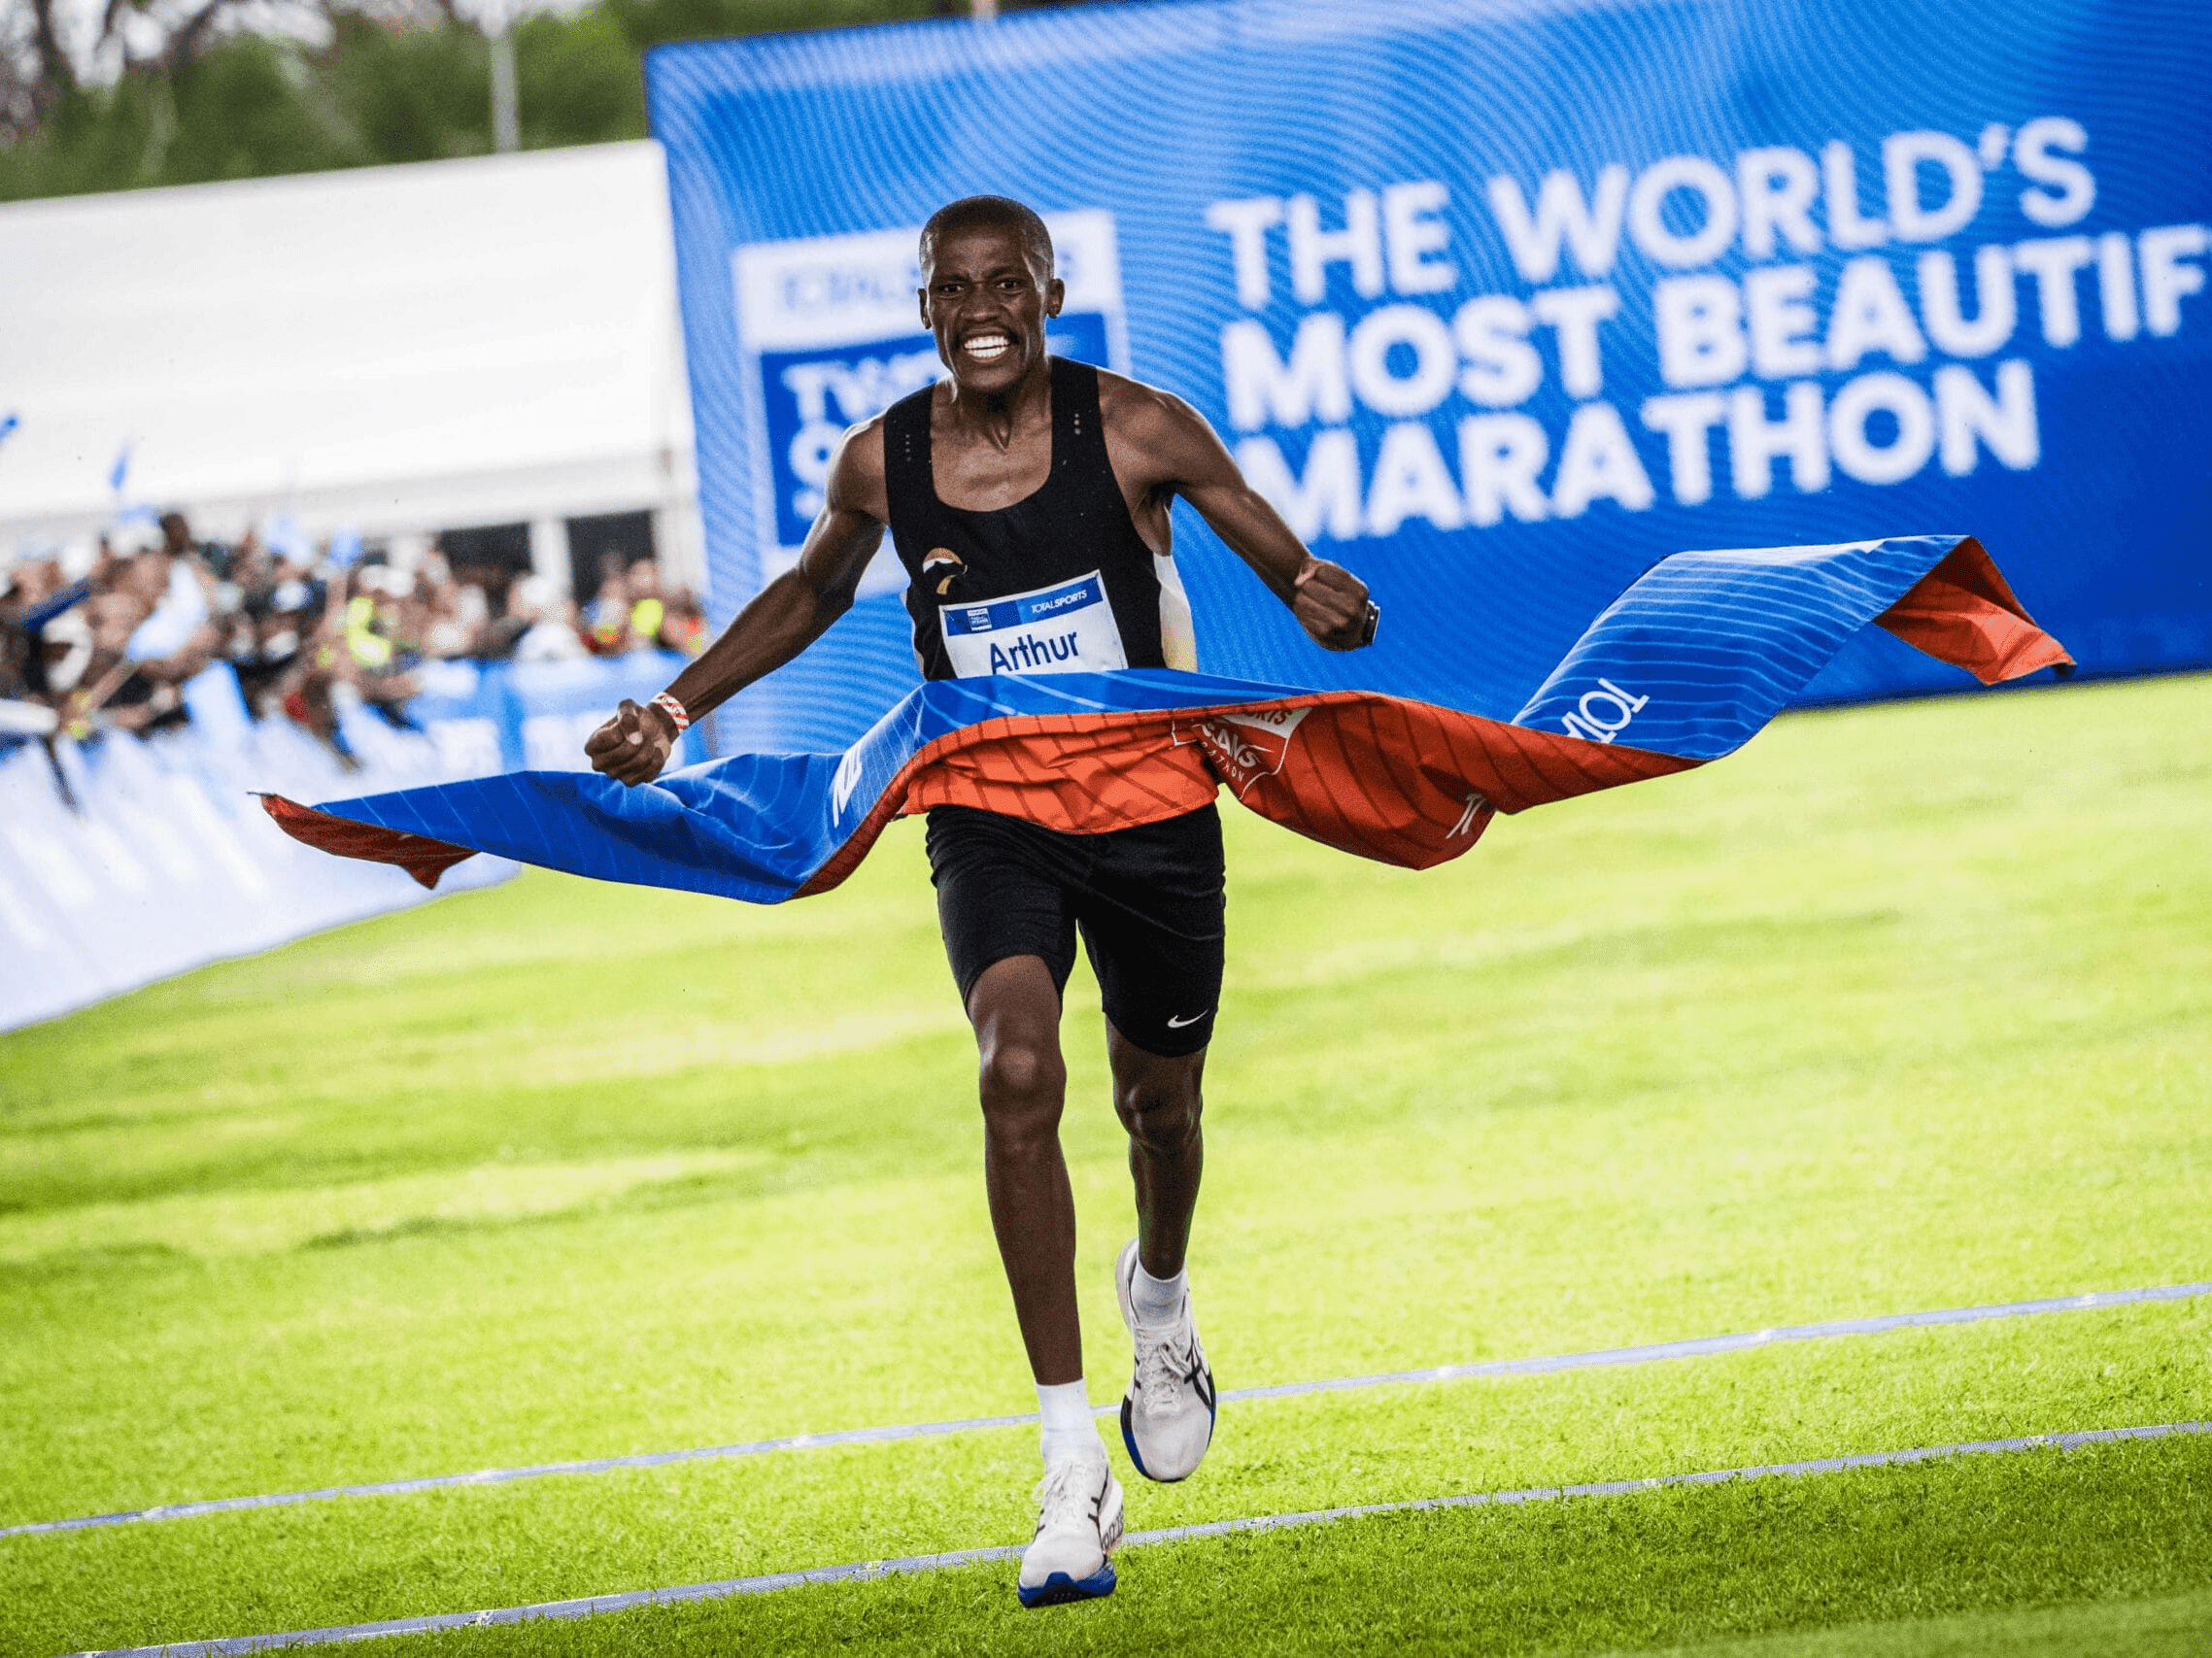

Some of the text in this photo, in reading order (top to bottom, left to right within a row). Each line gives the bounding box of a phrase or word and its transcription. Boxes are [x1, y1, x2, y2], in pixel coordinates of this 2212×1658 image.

[1205, 117, 2095, 311] THE WORLD'S
[1219, 223, 2212, 433] MOST BEAUTIF
[1234, 358, 2039, 542] MARATHON
[989, 631, 1079, 674] Arthur
[1032, 590, 1087, 614] TOTALSPORTS
